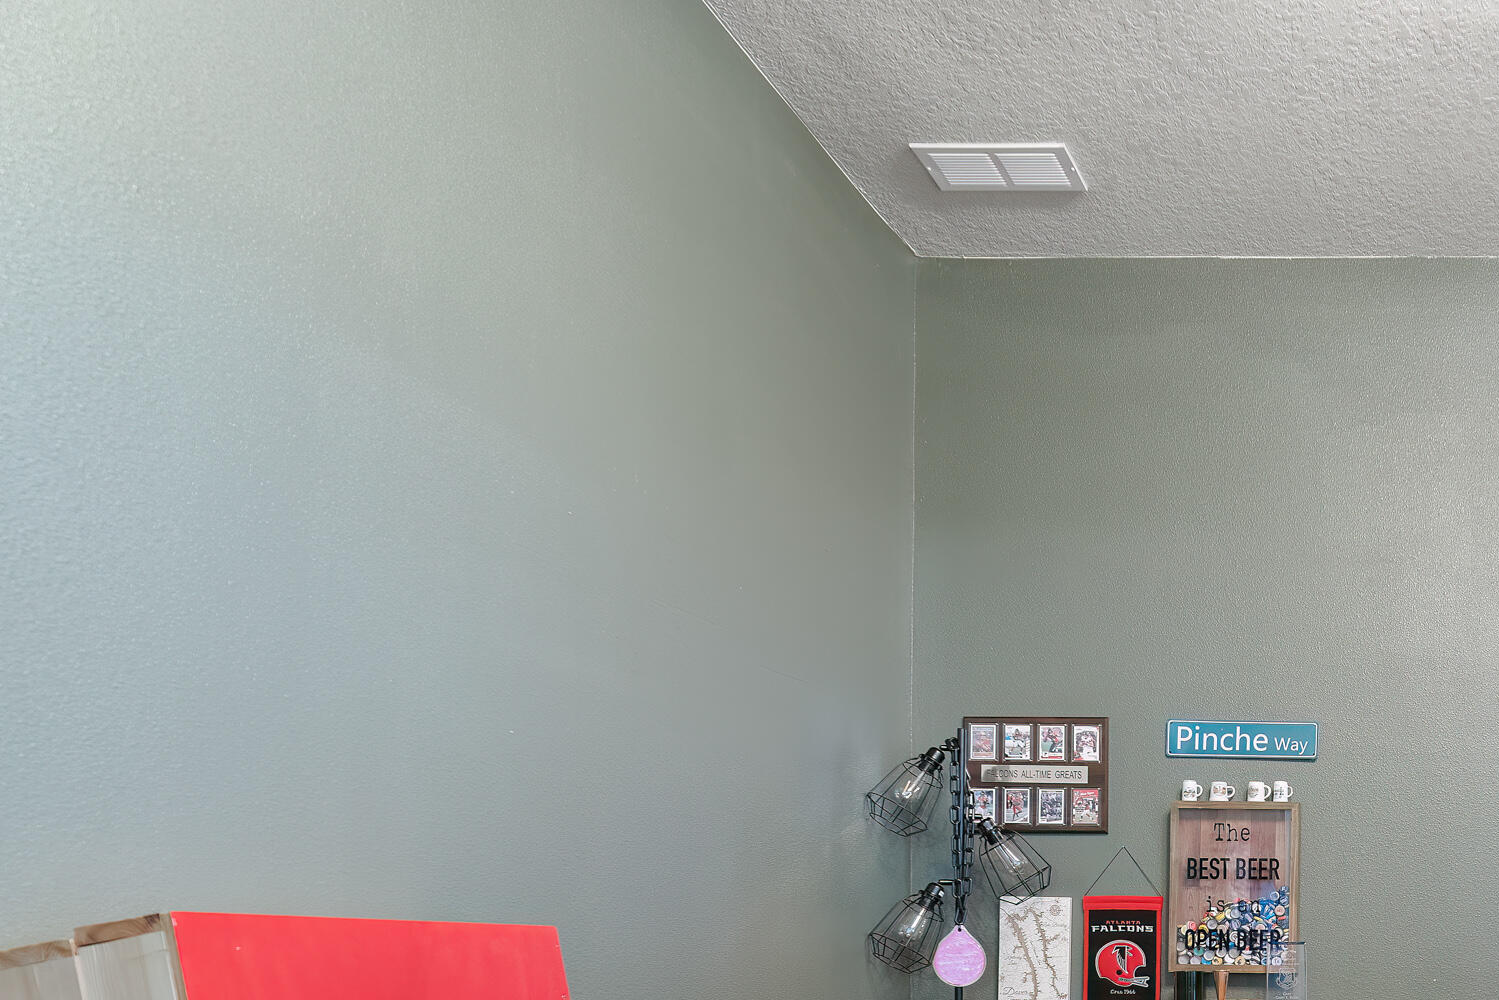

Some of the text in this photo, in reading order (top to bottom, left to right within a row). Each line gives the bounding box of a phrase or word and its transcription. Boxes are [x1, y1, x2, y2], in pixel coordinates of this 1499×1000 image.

[1177, 725, 1308, 755] Pinche Way
[986, 769, 1083, 780] FALCONS ALL-TIME GREATS
[1213, 822, 1251, 841] The
[1186, 857, 1280, 880] BEST BEER
[1206, 895, 1225, 912] is
[1091, 925, 1154, 933] FALCONS
[1184, 929, 1281, 951] OPEN BEER
